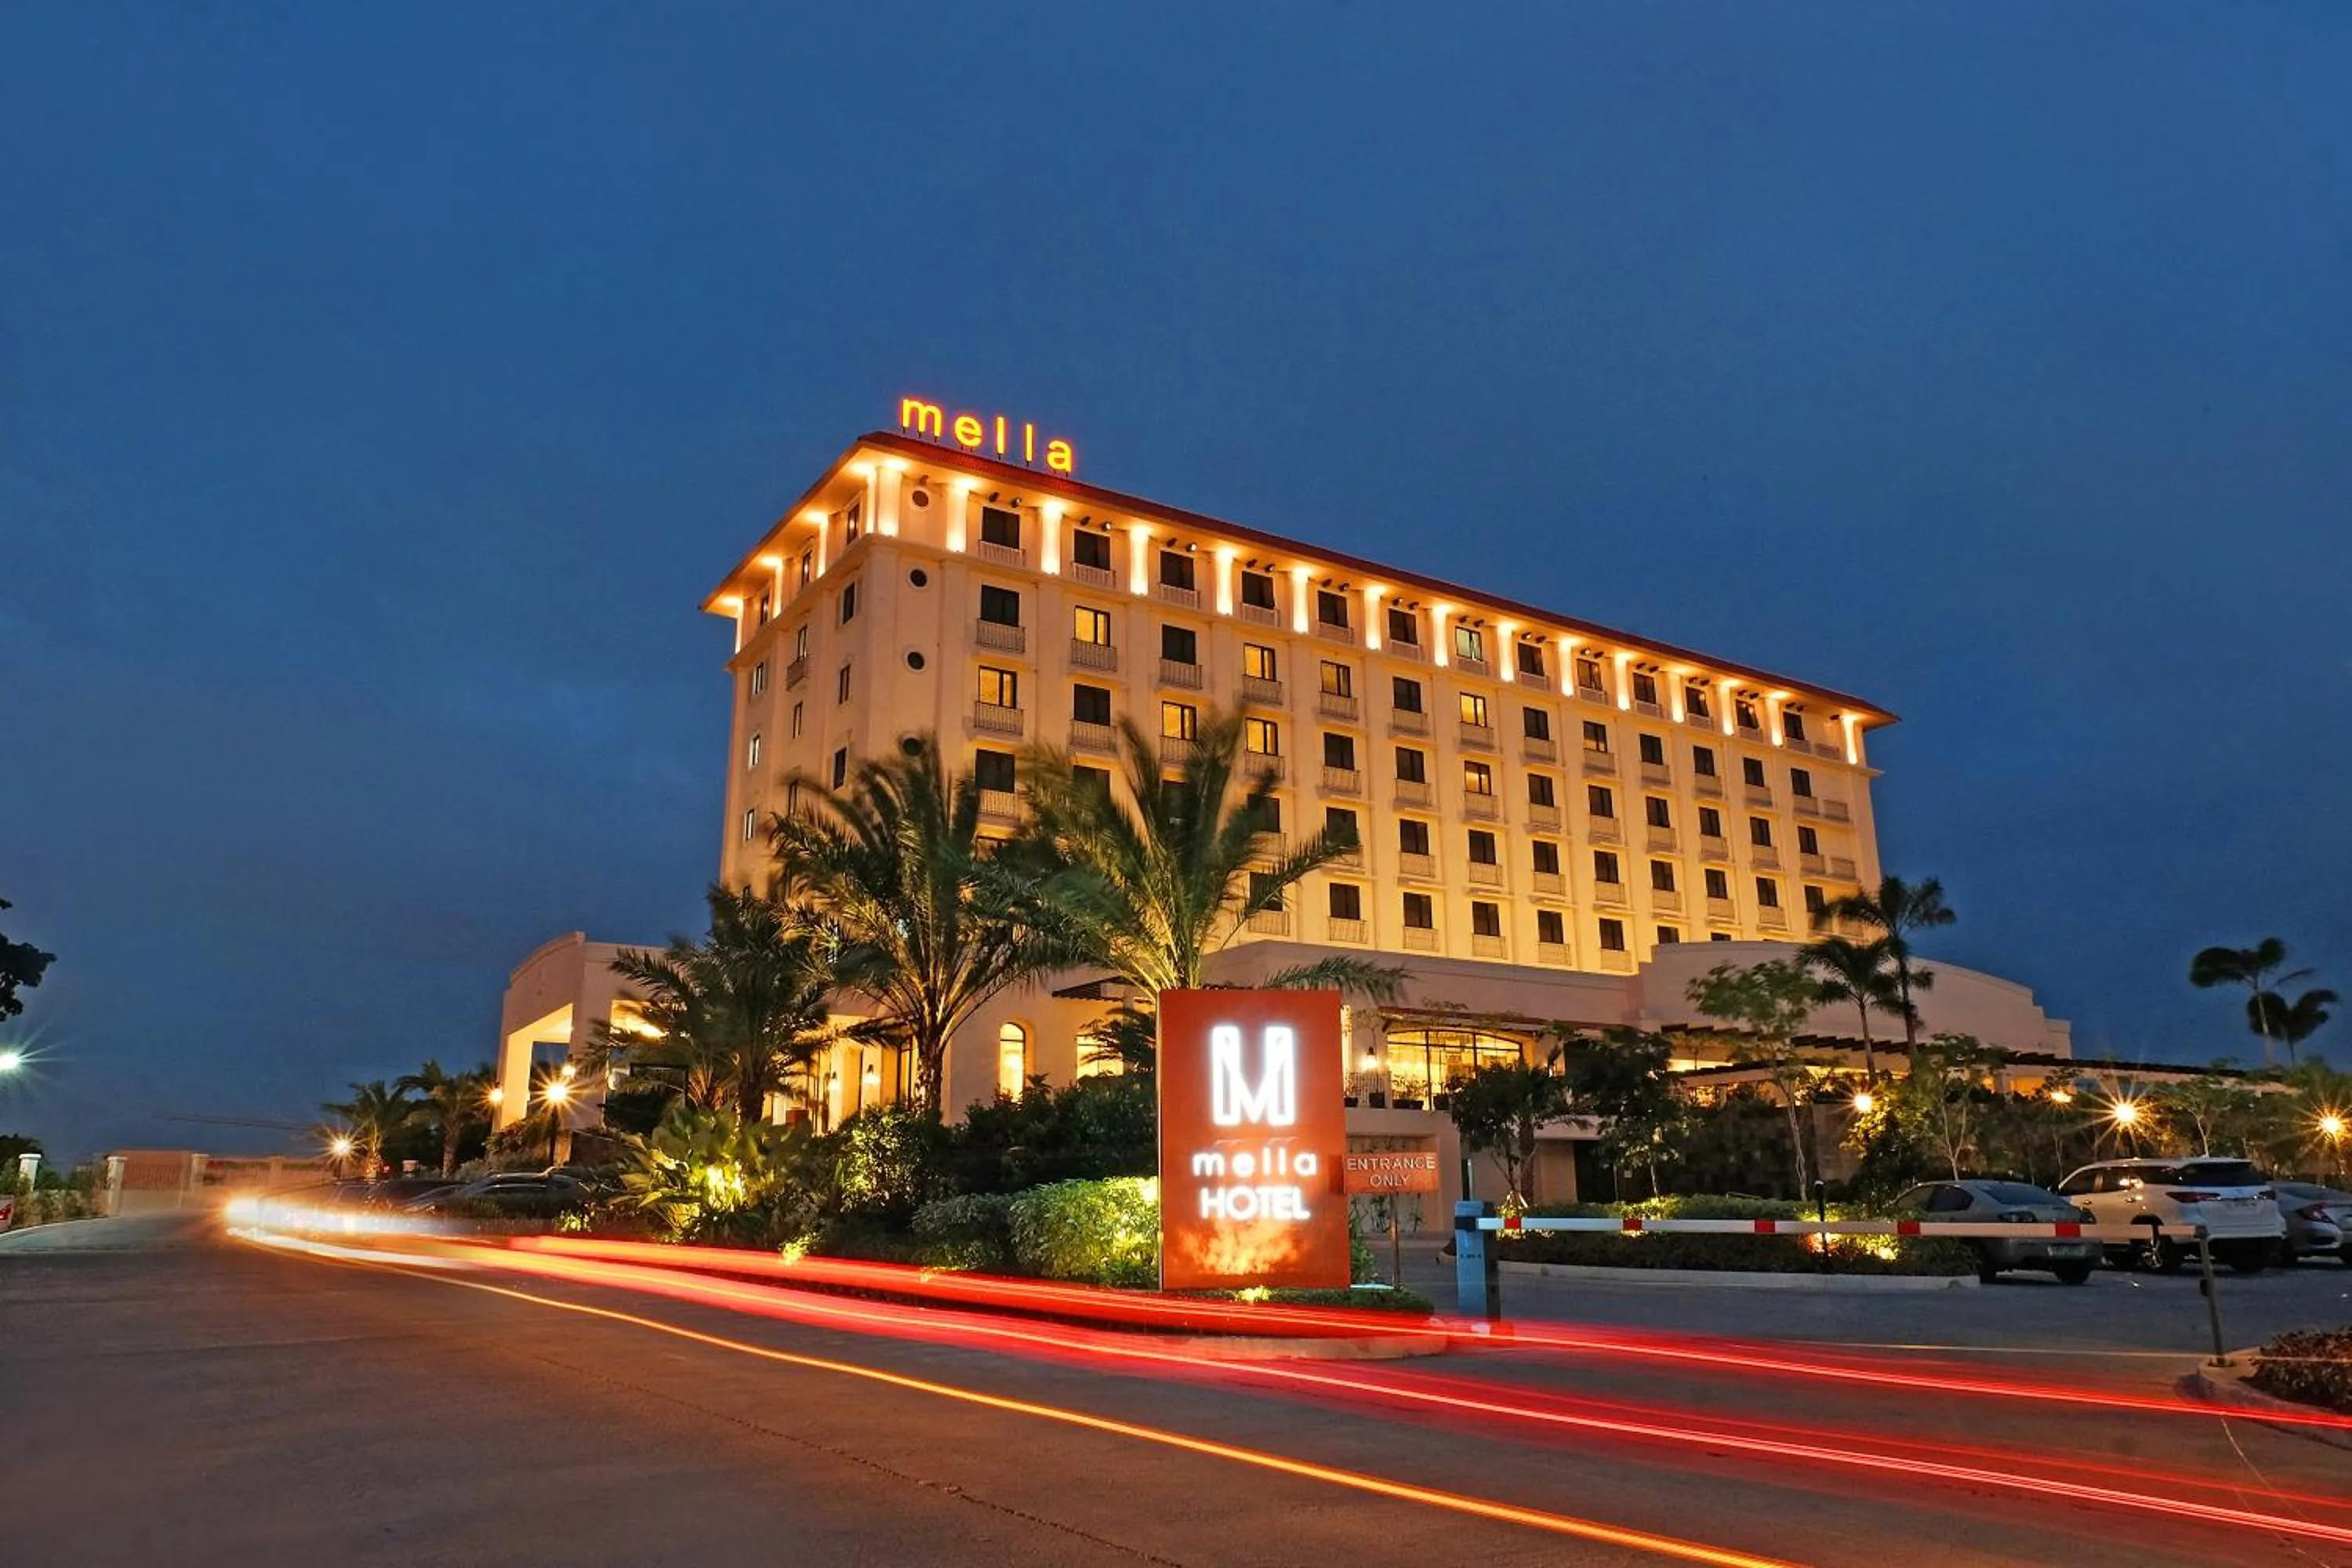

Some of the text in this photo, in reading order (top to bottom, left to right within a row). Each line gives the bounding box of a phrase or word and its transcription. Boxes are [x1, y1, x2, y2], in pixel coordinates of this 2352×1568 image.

[902, 398, 1072, 472] mella
[1211, 1025, 1294, 1126] M
[1192, 1146, 1317, 1177] mella
[1347, 1156, 1436, 1171] ENTRANCE
[1370, 1174, 1410, 1188] ONLY
[1200, 1185, 1310, 1220] HOTEL
